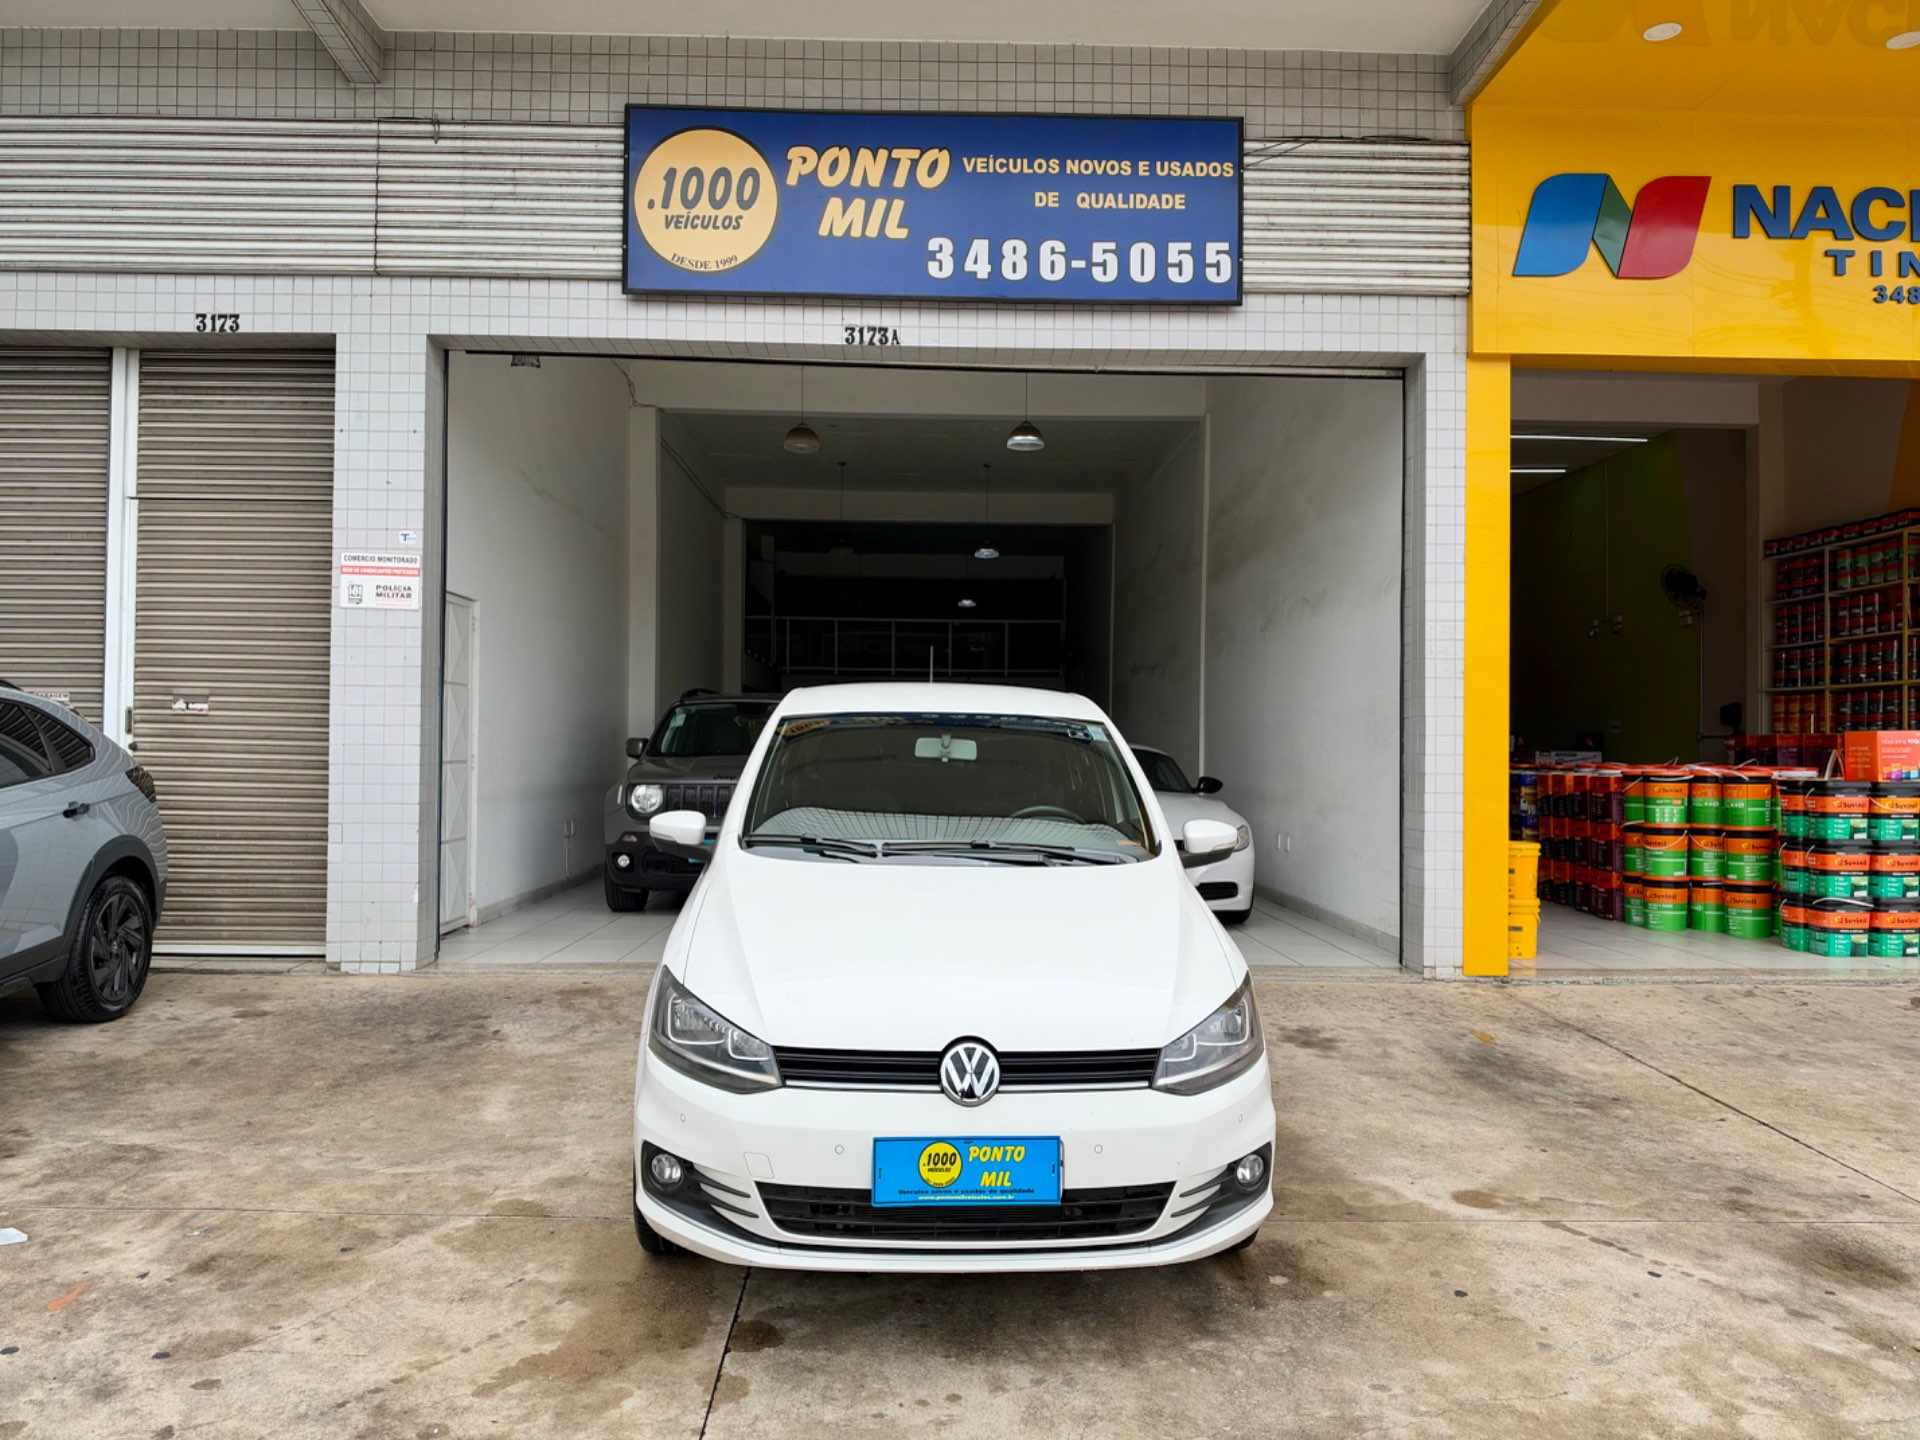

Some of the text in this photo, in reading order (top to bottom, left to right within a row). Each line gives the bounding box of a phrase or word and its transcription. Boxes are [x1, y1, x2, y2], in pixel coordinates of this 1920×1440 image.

[785, 145, 951, 190] PONTO
[962, 154, 1234, 178] VEÍCULOS NOVOS E USADOS
[1035, 191, 1186, 210] DE QUALIDADE
[664, 212, 743, 231] VEÍCULOS
[818, 197, 910, 240] MIL
[671, 253, 738, 269] DESDE 1999
[926, 236, 1233, 285] 3486-5055
[195, 313, 240, 333] 3173
[844, 326, 899, 347] 3173A
[377, 556, 418, 564] MONITORADO
[968, 1145, 1026, 1163] PONTO
[979, 1170, 1012, 1187] MIL
